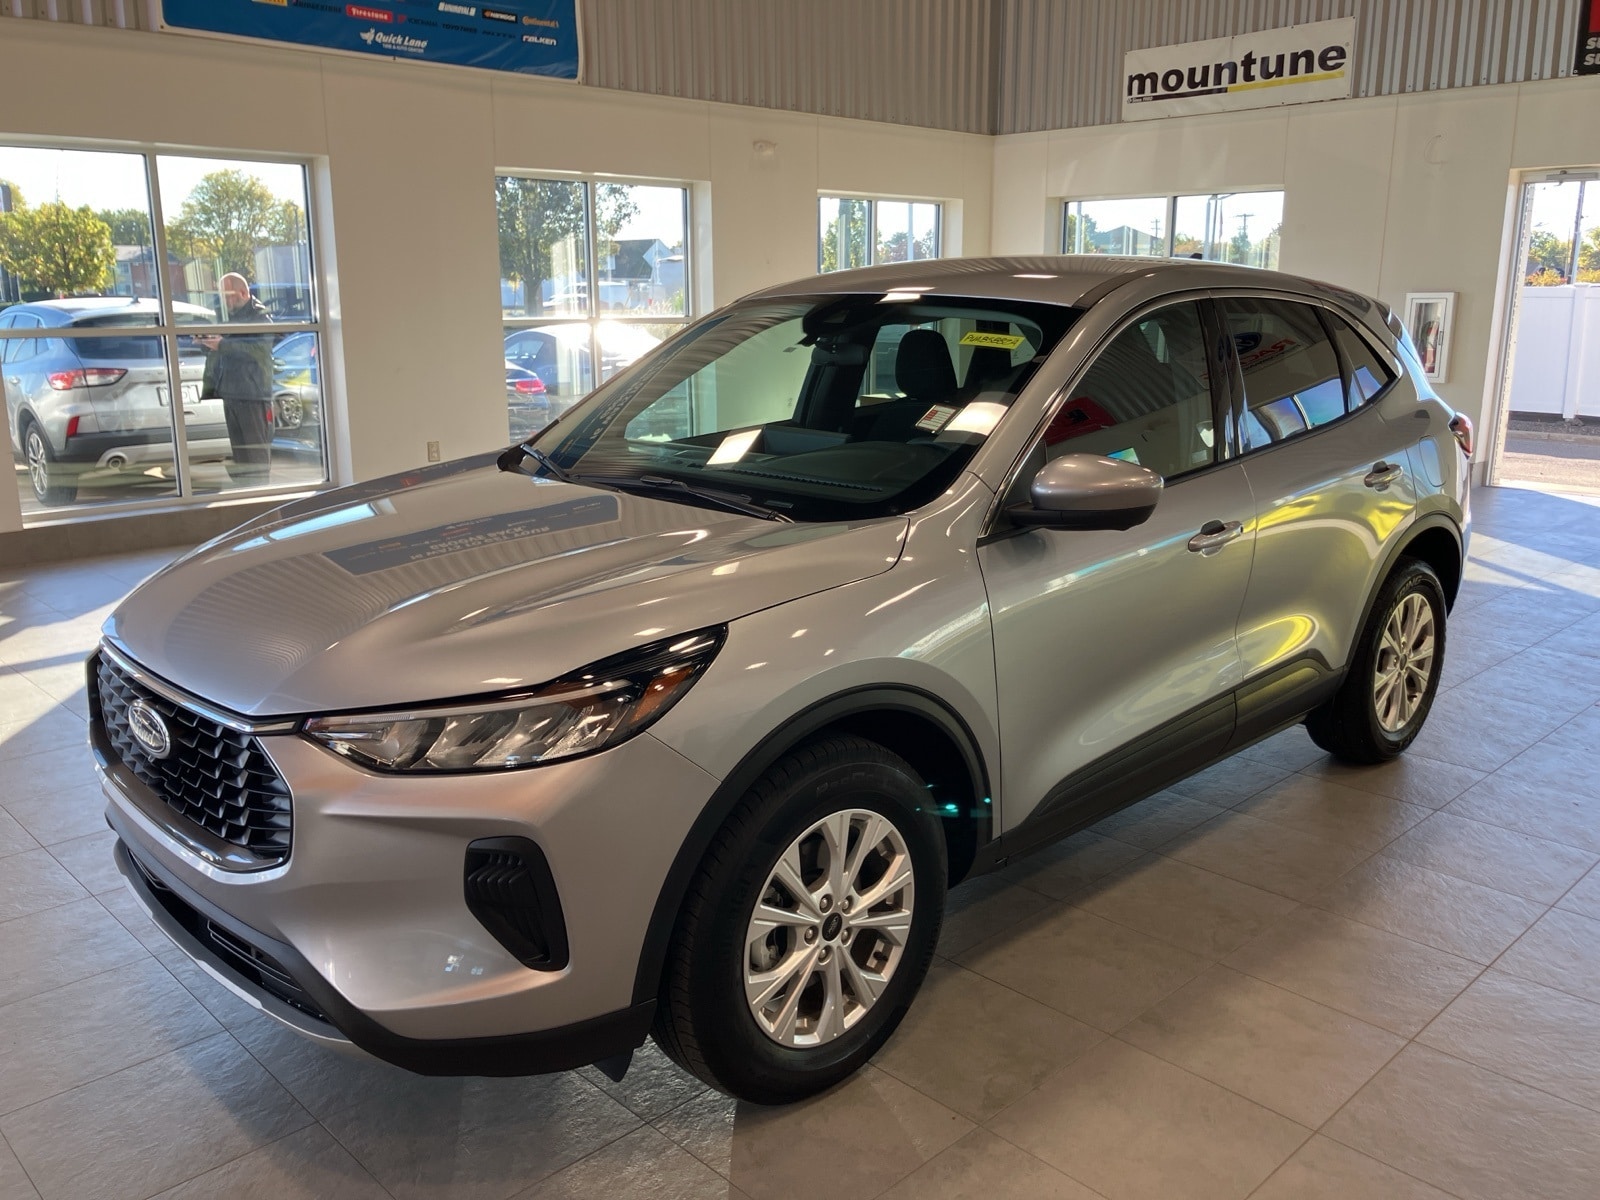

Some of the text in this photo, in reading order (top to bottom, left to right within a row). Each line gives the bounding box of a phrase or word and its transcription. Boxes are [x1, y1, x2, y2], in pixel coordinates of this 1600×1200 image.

[375, 31, 429, 48] Quick Lane
[522, 35, 557, 46] FALKEN
[1127, 46, 1347, 97] mountune
